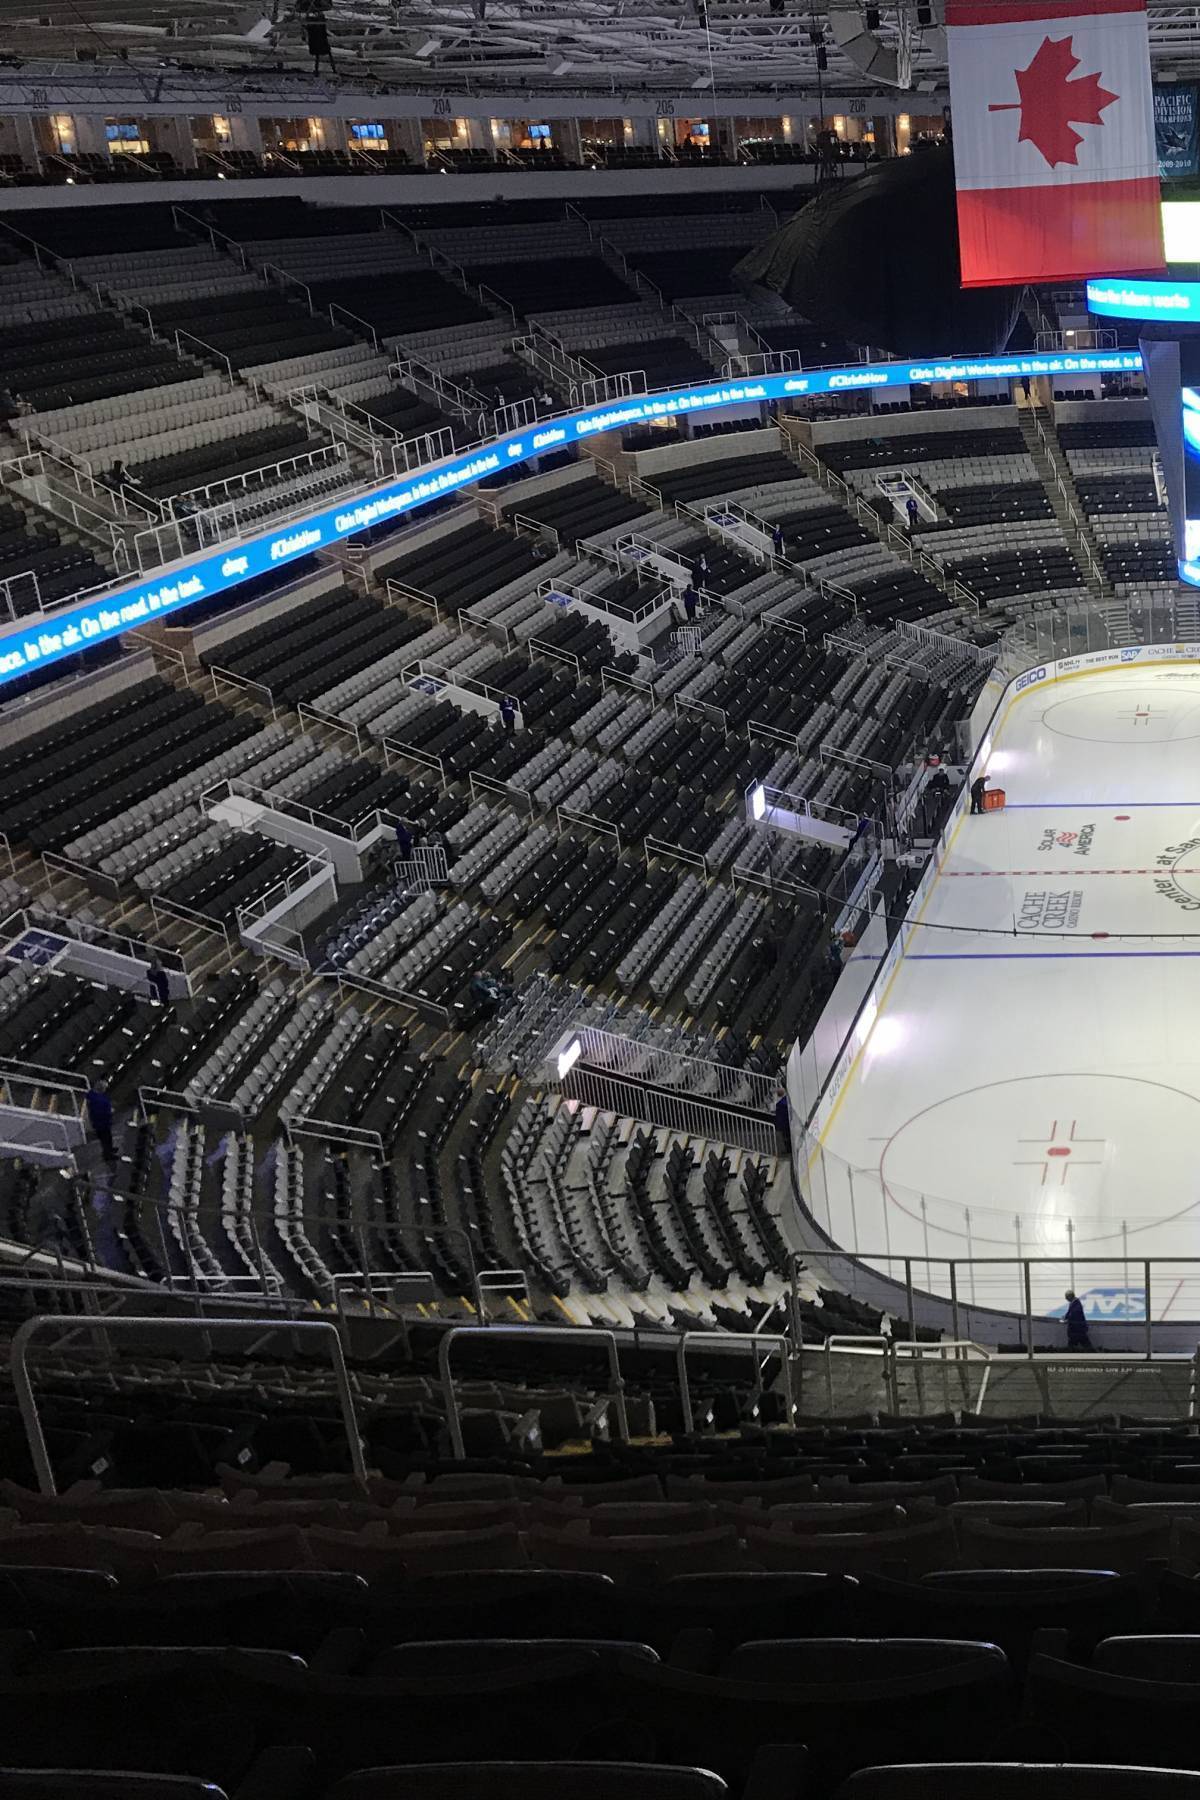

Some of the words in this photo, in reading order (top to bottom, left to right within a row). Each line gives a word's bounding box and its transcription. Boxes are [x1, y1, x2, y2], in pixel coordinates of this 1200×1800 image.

[432, 99, 451, 114] 204
[656, 100, 675, 115] 205
[1155, 95, 1192, 106] PACIFIC
[1155, 105, 1192, 115] DIVISION
[1155, 114, 1193, 123] CHAMPIONS
[909, 368, 934, 380] Citrix
[934, 366, 966, 380] Digital
[966, 364, 1021, 376] Workspace.
[1021, 361, 1031, 372] In
[1031, 360, 1049, 371] the
[1064, 358, 1079, 370] On
[1080, 358, 1097, 370] the
[1097, 357, 1122, 369] road.
[335, 513, 357, 532] Citrix
[355, 503, 378, 525] Digital
[24, 642, 40, 661] In
[39, 634, 62, 656] the
[81, 618, 100, 638] On
[99, 610, 120, 631] the
[120, 596, 149, 622] road.
[160, 587, 179, 606] the
[1121, 649, 1139, 662] SAP
[1015, 667, 1047, 692] GEICO
[1037, 829, 1057, 851] SOLAR
[1073, 823, 1096, 856] AMERICA
[1156, 854, 1176, 866] at
[1017, 891, 1047, 929] CACHE
[1042, 890, 1071, 929] CREEK
